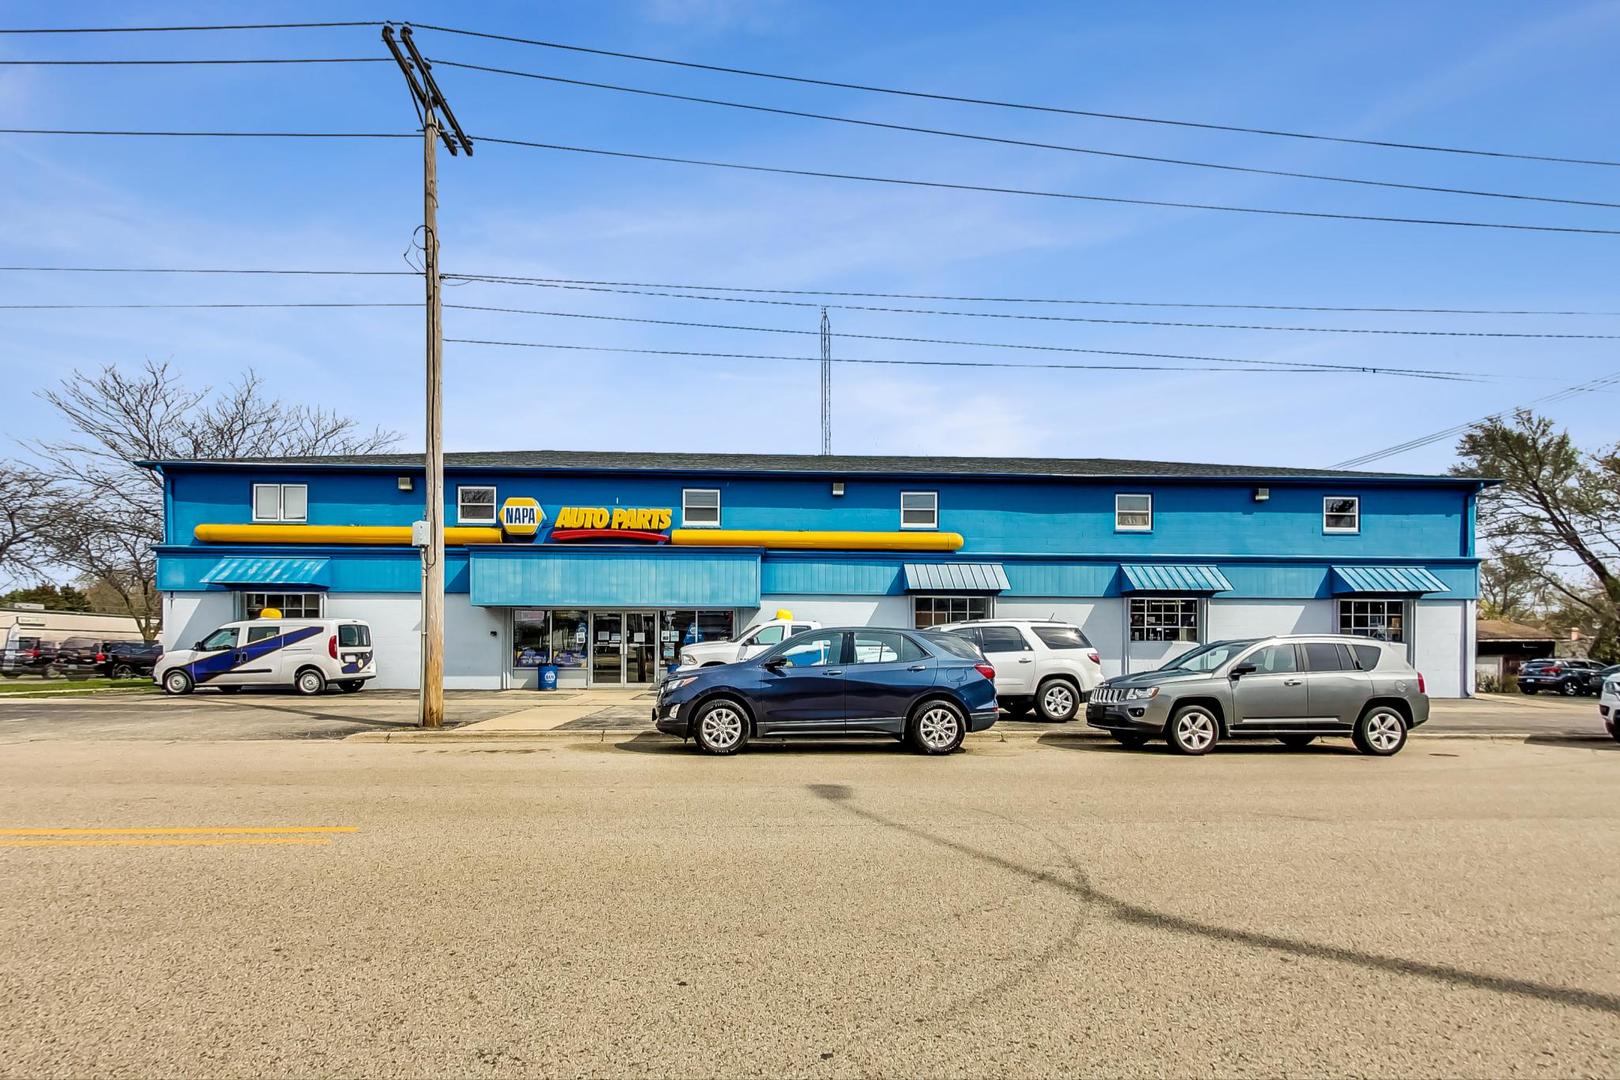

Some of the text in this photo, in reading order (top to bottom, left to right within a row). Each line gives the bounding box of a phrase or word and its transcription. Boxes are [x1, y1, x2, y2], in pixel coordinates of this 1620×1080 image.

[505, 507, 536, 524] NAPA
[554, 507, 673, 530] AUTO PARTS
